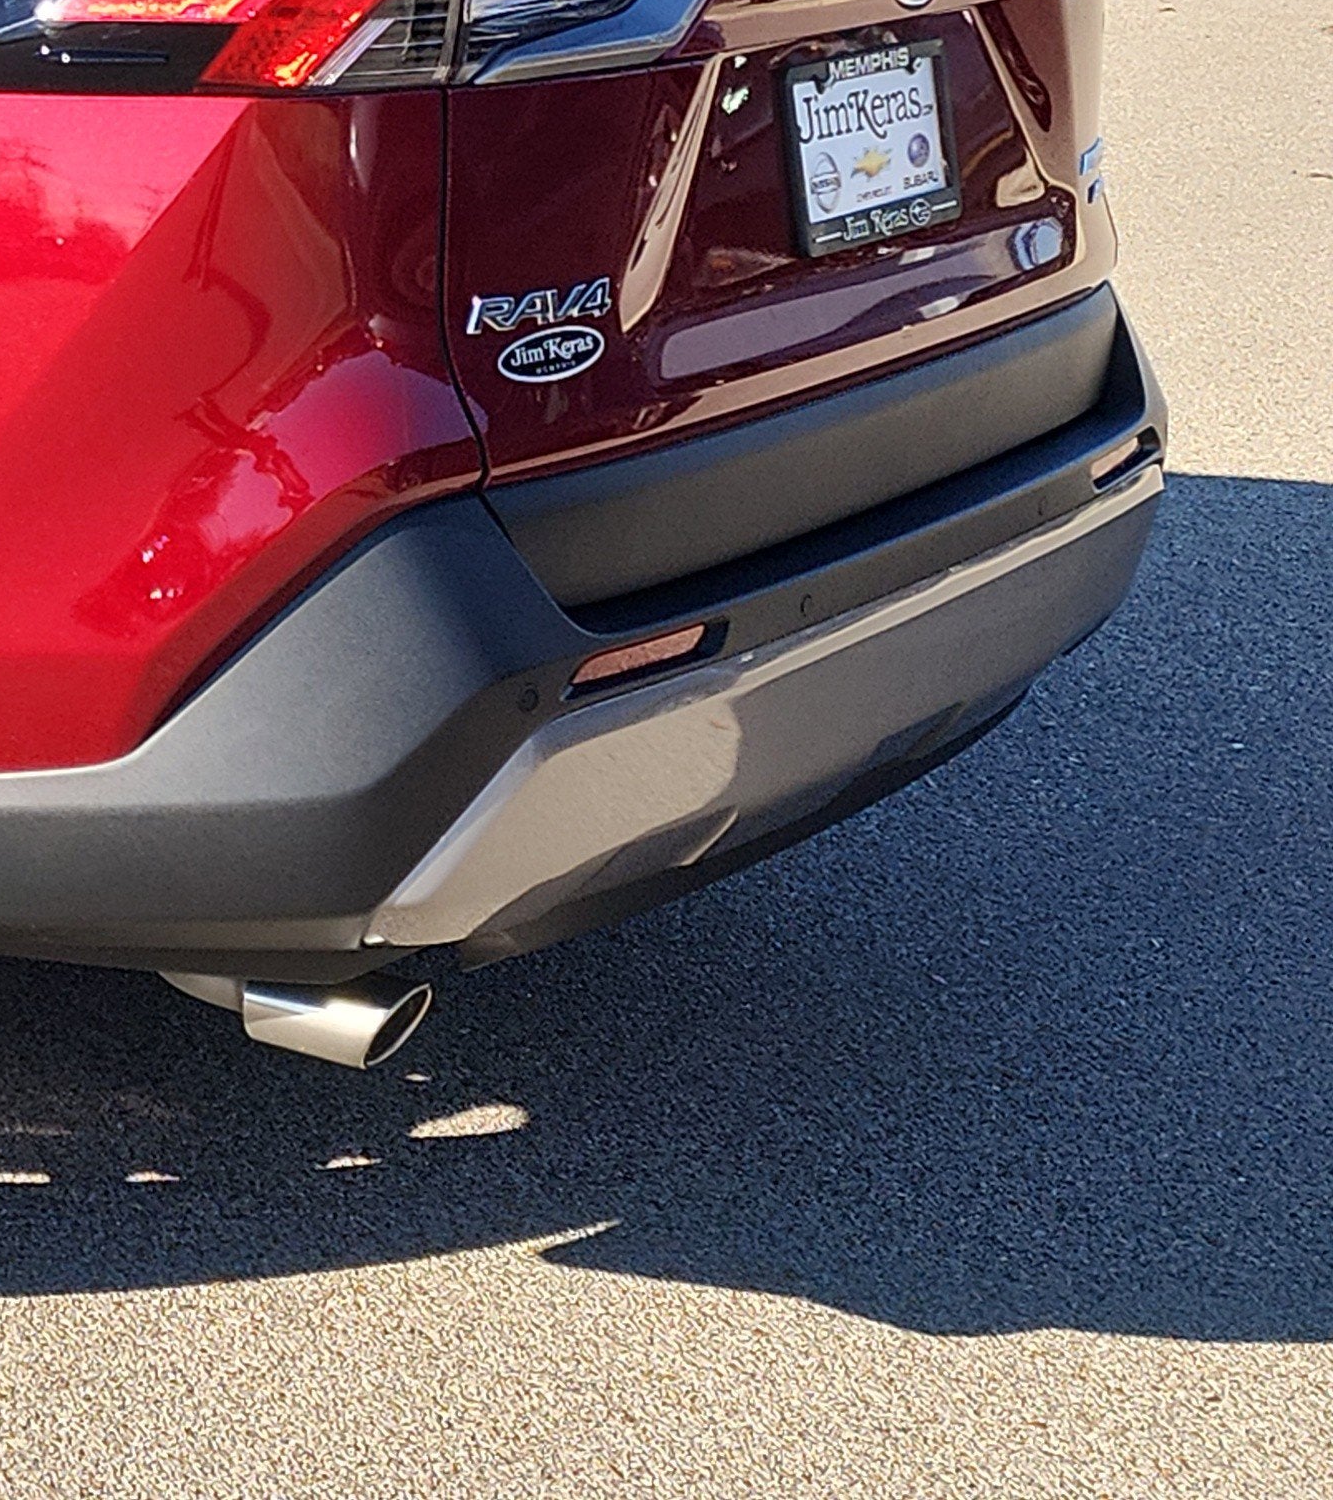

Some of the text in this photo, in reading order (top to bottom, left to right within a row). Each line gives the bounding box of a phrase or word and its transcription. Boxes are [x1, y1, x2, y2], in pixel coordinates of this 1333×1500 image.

[828, 47, 910, 79] MEMPHIS
[466, 276, 612, 334] RAV4
[510, 335, 595, 367] Jim Keras
